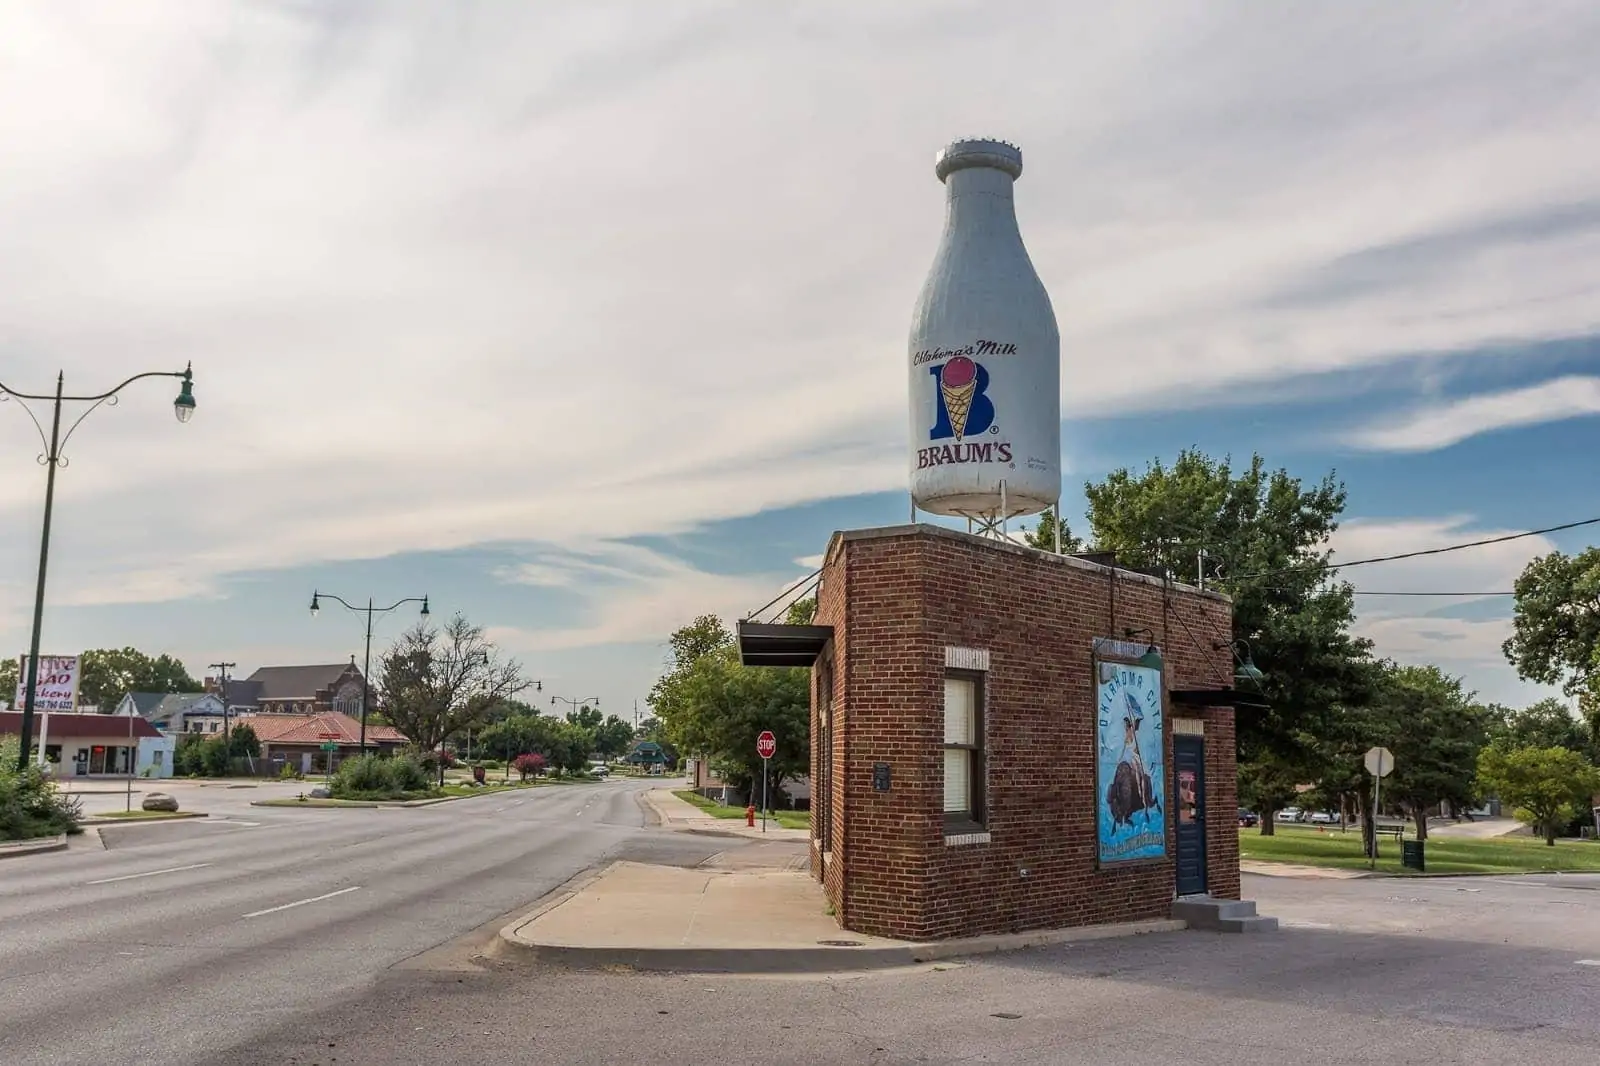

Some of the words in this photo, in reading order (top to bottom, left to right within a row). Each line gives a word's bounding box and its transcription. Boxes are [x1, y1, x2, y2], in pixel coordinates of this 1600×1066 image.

[913, 345, 975, 367] Oklahoma's
[976, 339, 1018, 356] Milk
[917, 442, 1013, 470] BRAUM'S
[1099, 671, 1143, 728] OKLAHOMA
[1146, 689, 1162, 730] CITY
[759, 739, 775, 750] STOP
